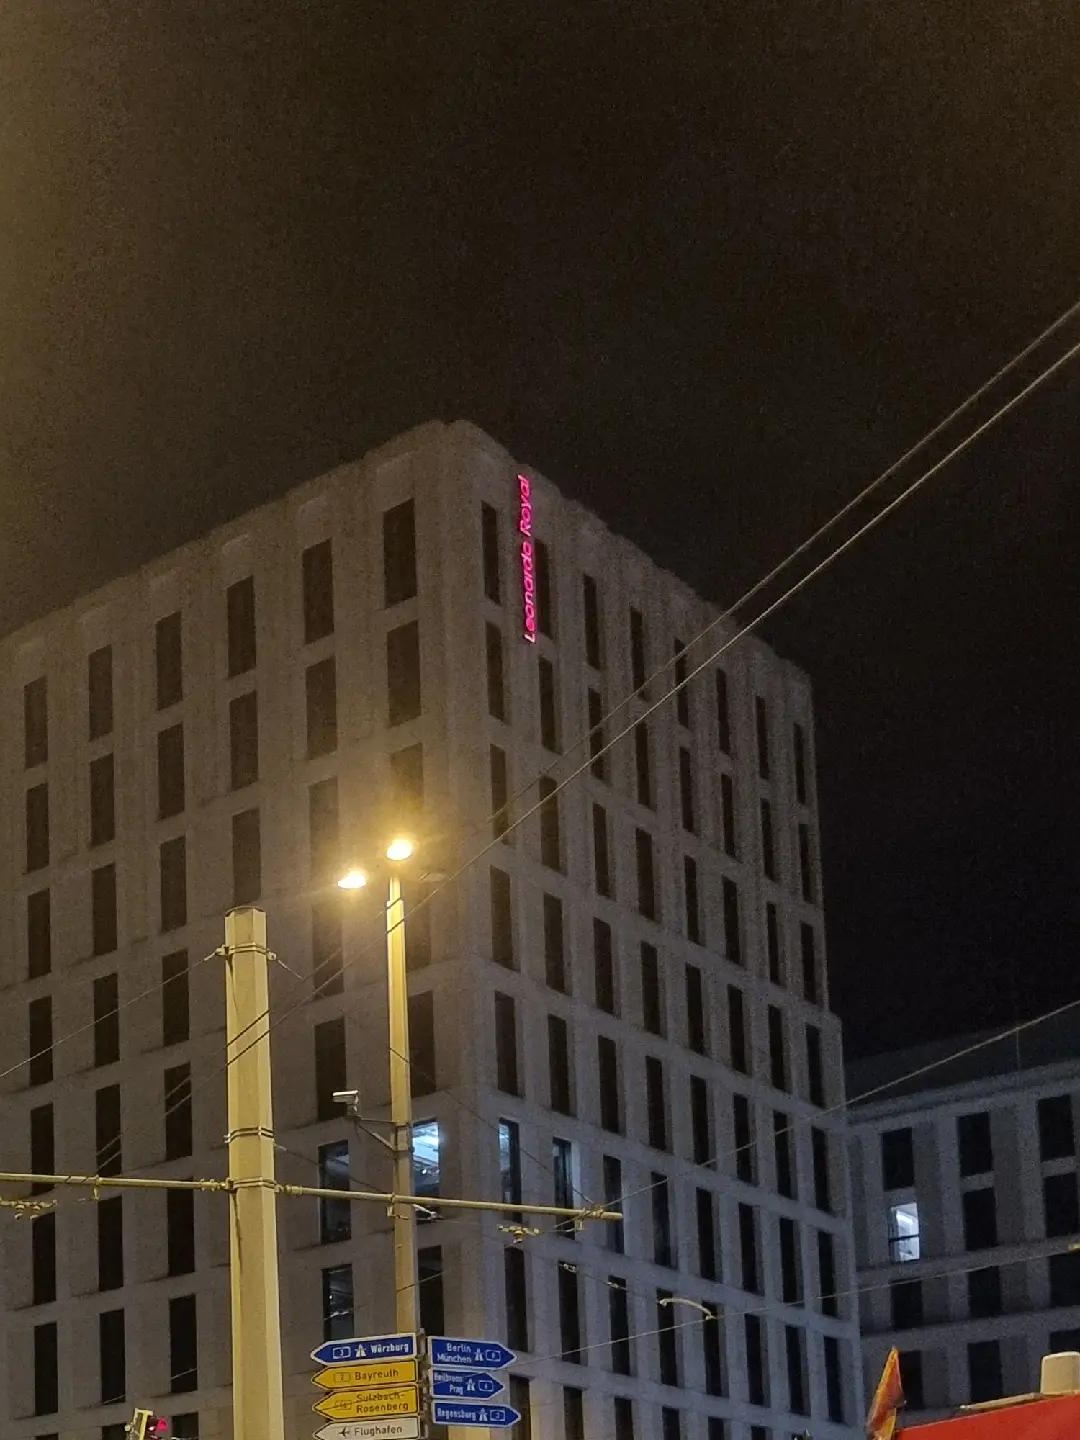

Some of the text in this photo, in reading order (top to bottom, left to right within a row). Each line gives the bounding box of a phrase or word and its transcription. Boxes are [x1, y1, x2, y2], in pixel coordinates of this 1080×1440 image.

[517, 474, 533, 537] Royal
[371, 1343, 409, 1354] Würzburg
[446, 1343, 471, 1353] Berlin
[437, 1353, 472, 1363] München
[354, 1369, 399, 1381] Bayreuth
[449, 1384, 464, 1395] Prag
[356, 1391, 405, 1402] Sulzbach-
[356, 1402, 409, 1413] Rosenberg
[437, 1408, 477, 1421] Regensburg
[354, 1425, 403, 1436] Flughafen
